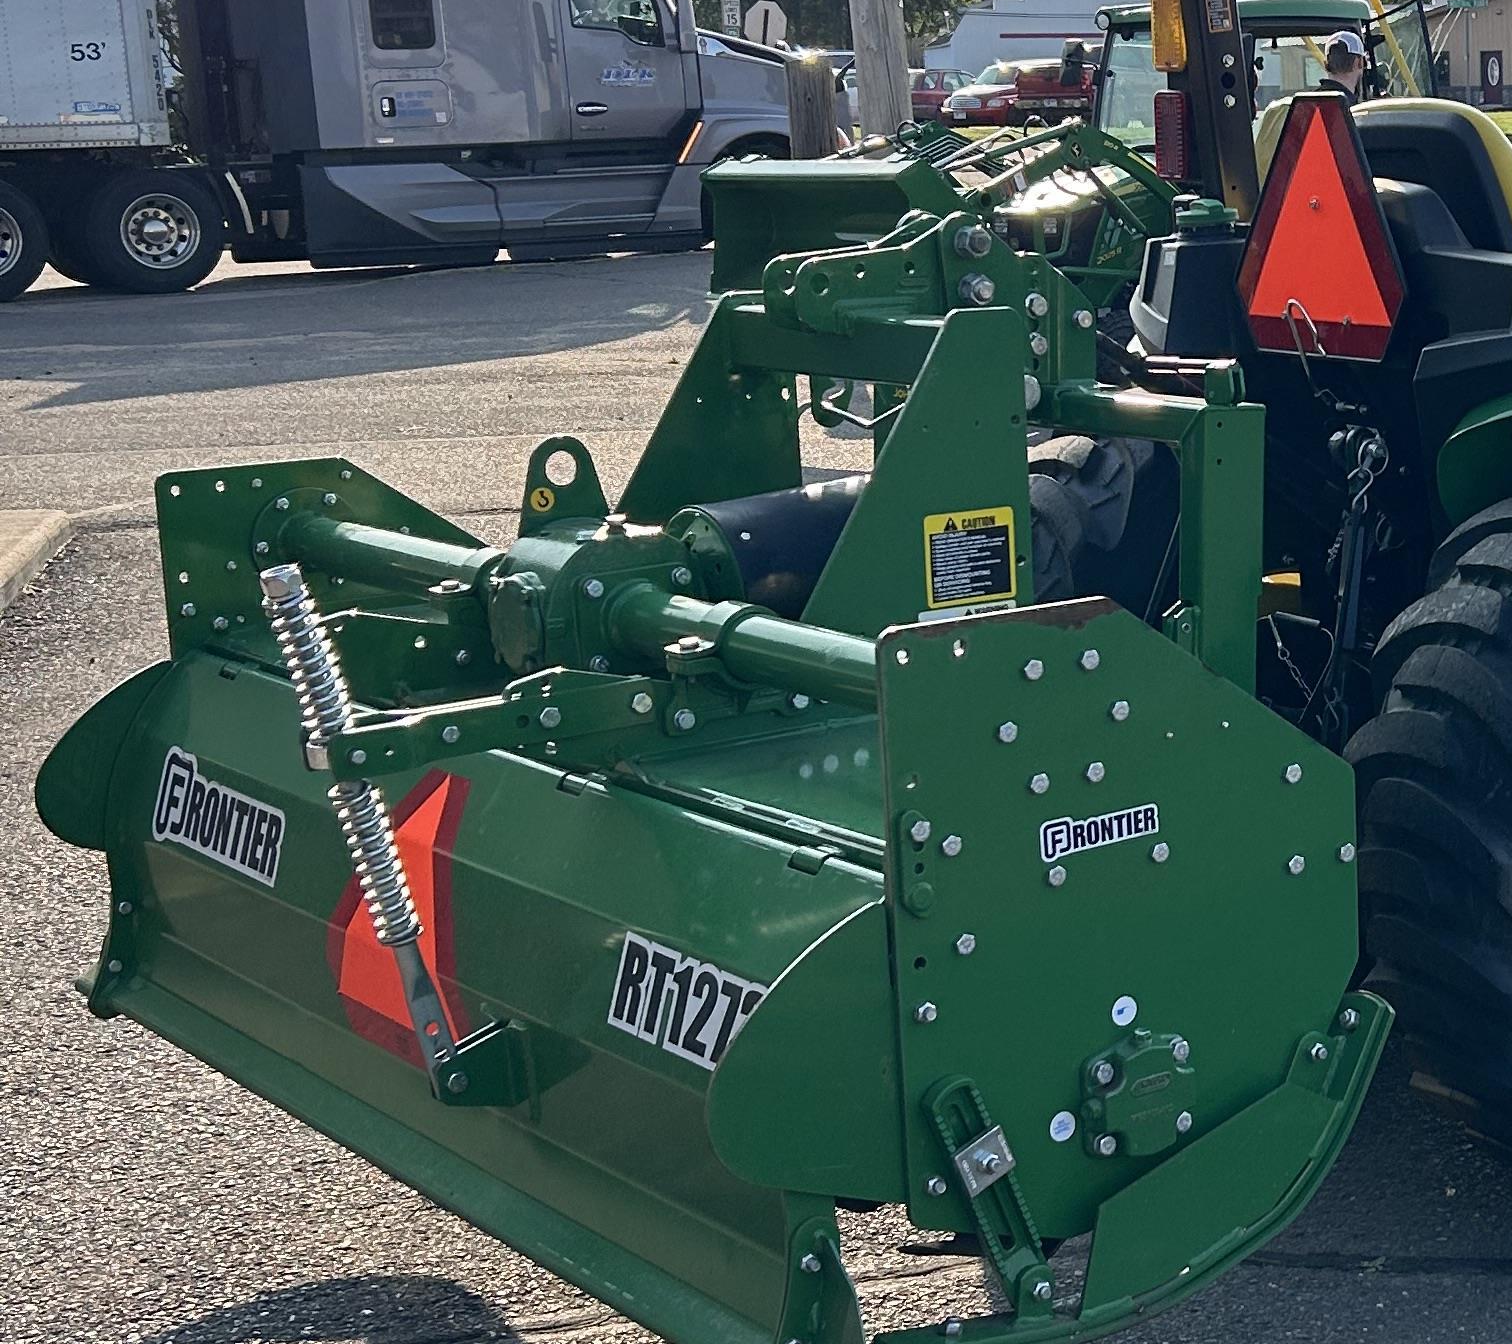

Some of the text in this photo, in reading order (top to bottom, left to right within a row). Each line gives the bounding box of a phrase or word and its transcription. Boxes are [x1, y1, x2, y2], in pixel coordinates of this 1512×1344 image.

[726, 14, 738, 25] 15
[961, 516, 996, 530] CAUTION
[155, 752, 282, 879] FRONTIER
[1043, 807, 1157, 859] FRONTIER
